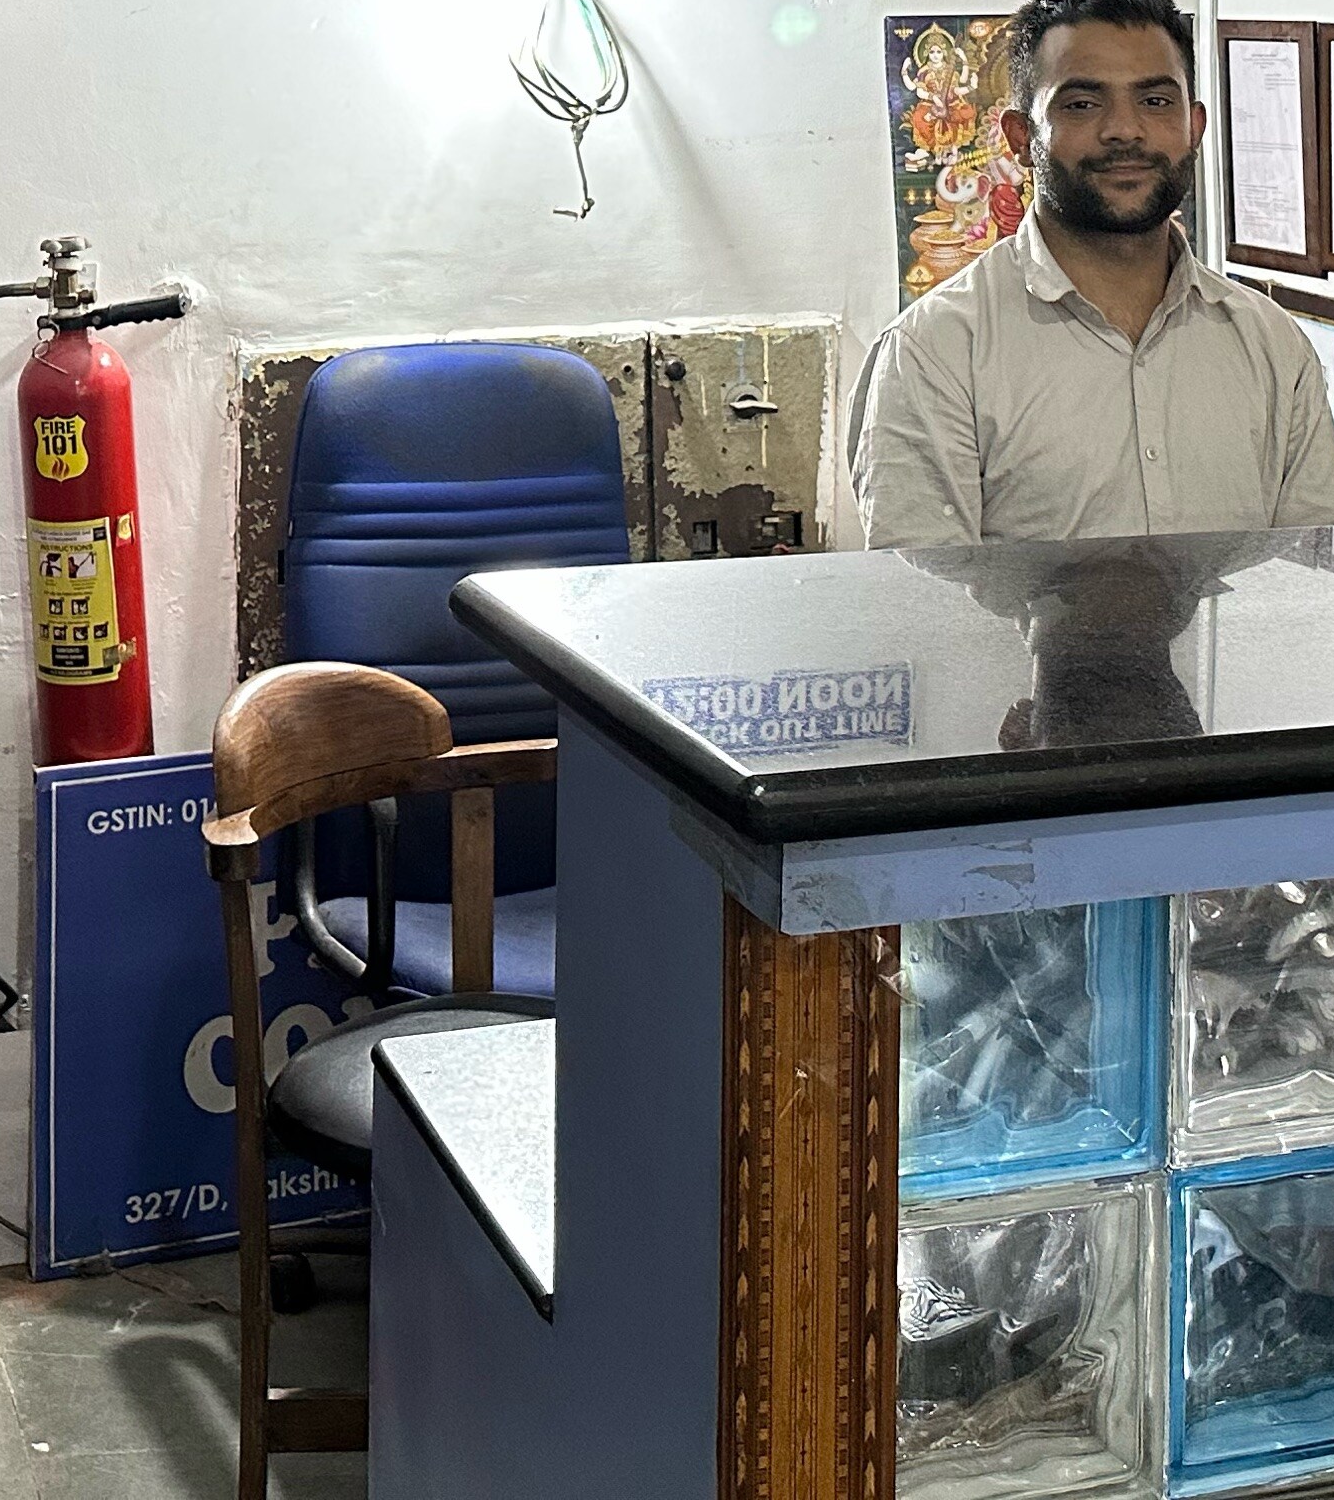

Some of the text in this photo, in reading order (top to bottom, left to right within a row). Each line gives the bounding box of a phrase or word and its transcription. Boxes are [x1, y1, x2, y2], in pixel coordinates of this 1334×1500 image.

[41, 420, 76, 435] FIRE
[42, 434, 77, 455] 101
[87, 803, 173, 834] GSTIN:
[125, 1184, 228, 1224] 327/D,
